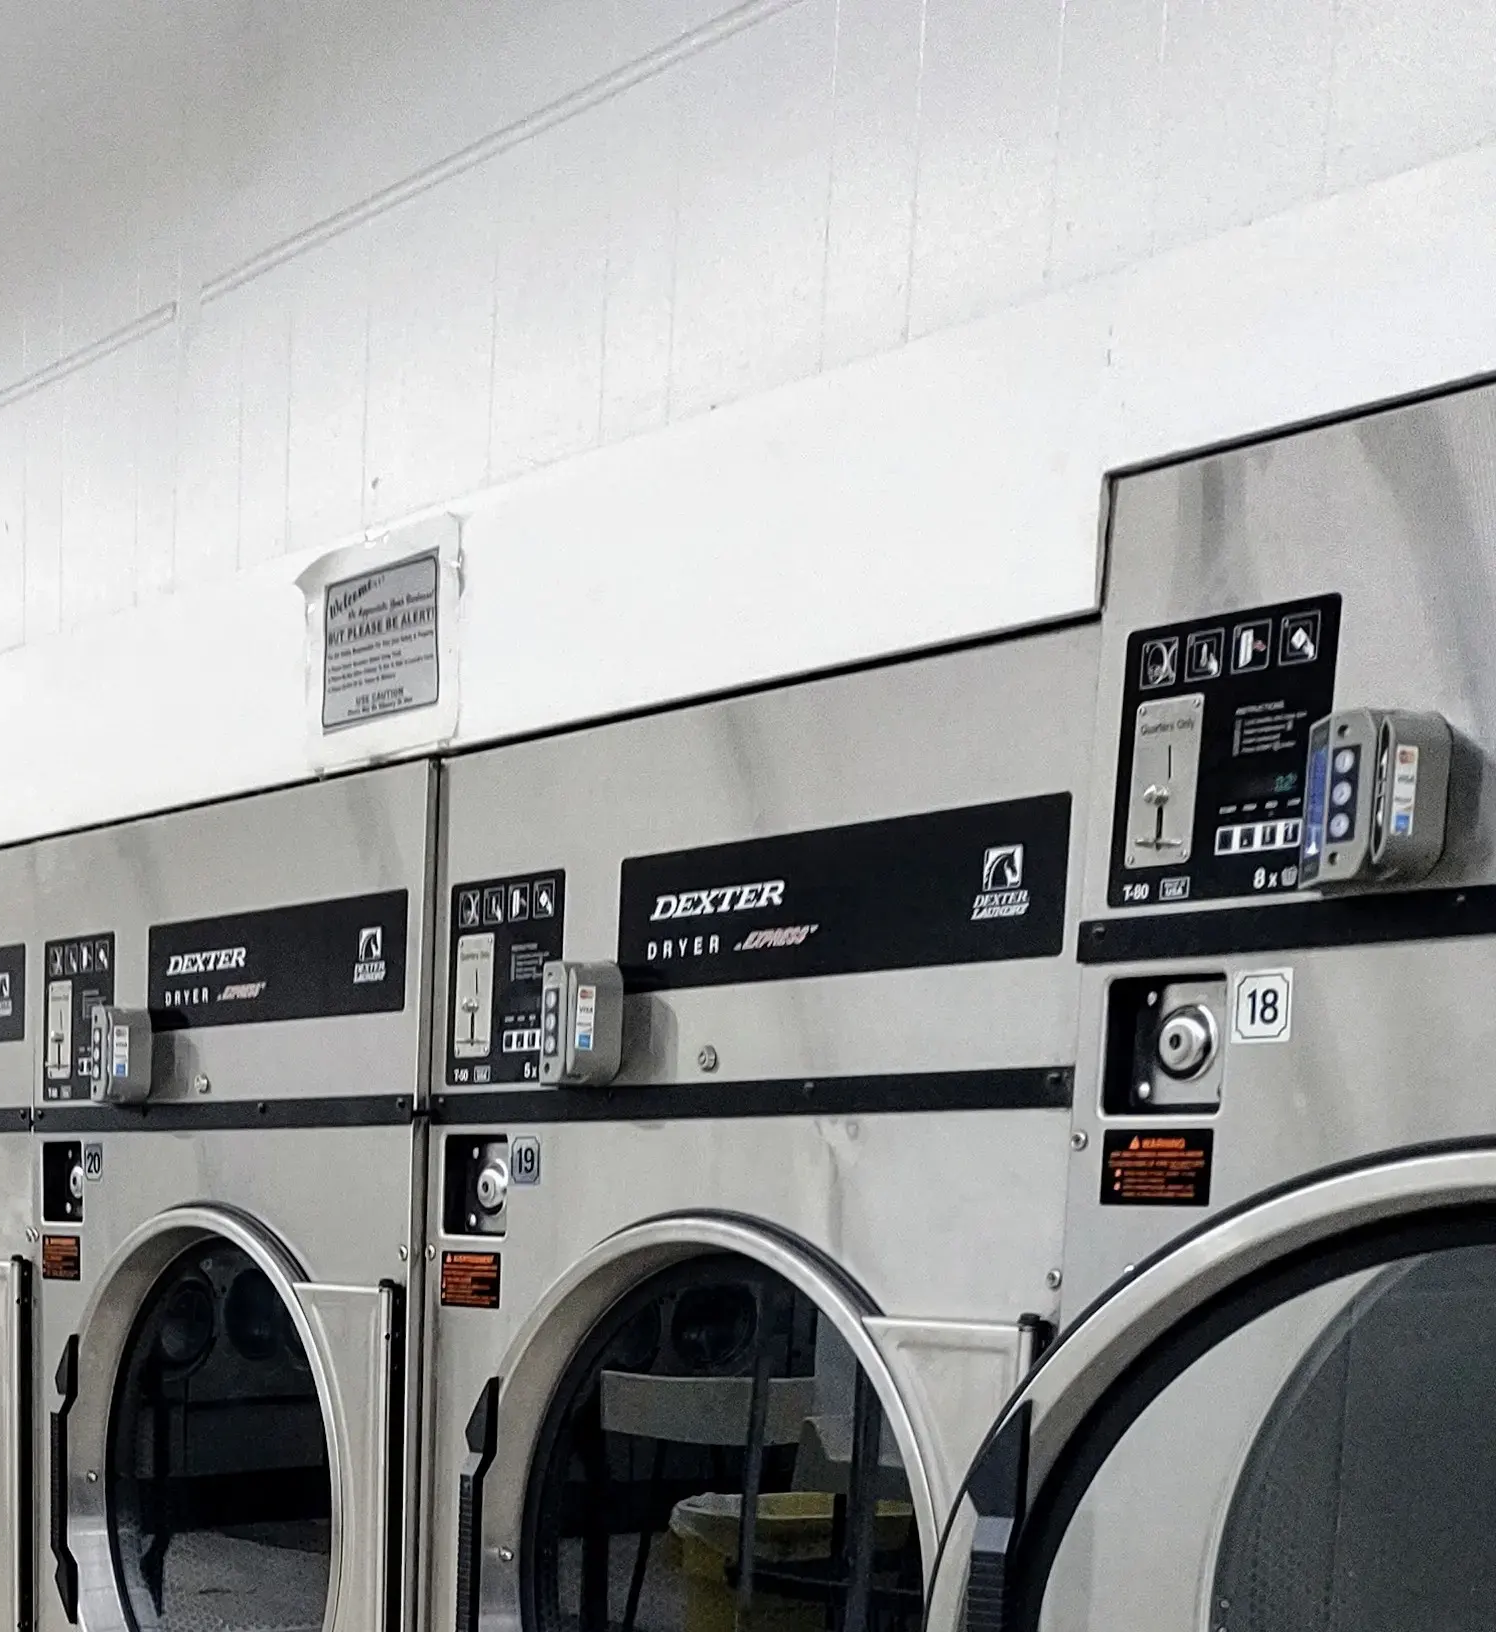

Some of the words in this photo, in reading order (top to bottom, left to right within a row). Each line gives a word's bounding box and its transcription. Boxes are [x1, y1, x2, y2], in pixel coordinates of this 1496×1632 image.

[328, 629, 344, 646] BUT
[347, 620, 381, 640] PLEASE
[386, 615, 398, 631] BE
[371, 687, 404, 702] CAUTION
[1140, 723, 1174, 736] Quarters
[1176, 717, 1195, 732] Only
[1253, 866, 1266, 889] 8
[649, 879, 786, 921] DEXTER
[973, 890, 1030, 909] DEXTER
[1122, 883, 1150, 901] T-80
[970, 903, 1030, 920] LAUNDRY
[647, 934, 720, 961] DRYER
[166, 946, 247, 977] DEXTER
[165, 987, 209, 1007] DRYER
[1247, 988, 1279, 1026] 18
[87, 1152, 101, 1174] 20
[516, 1147, 536, 1174] 19
